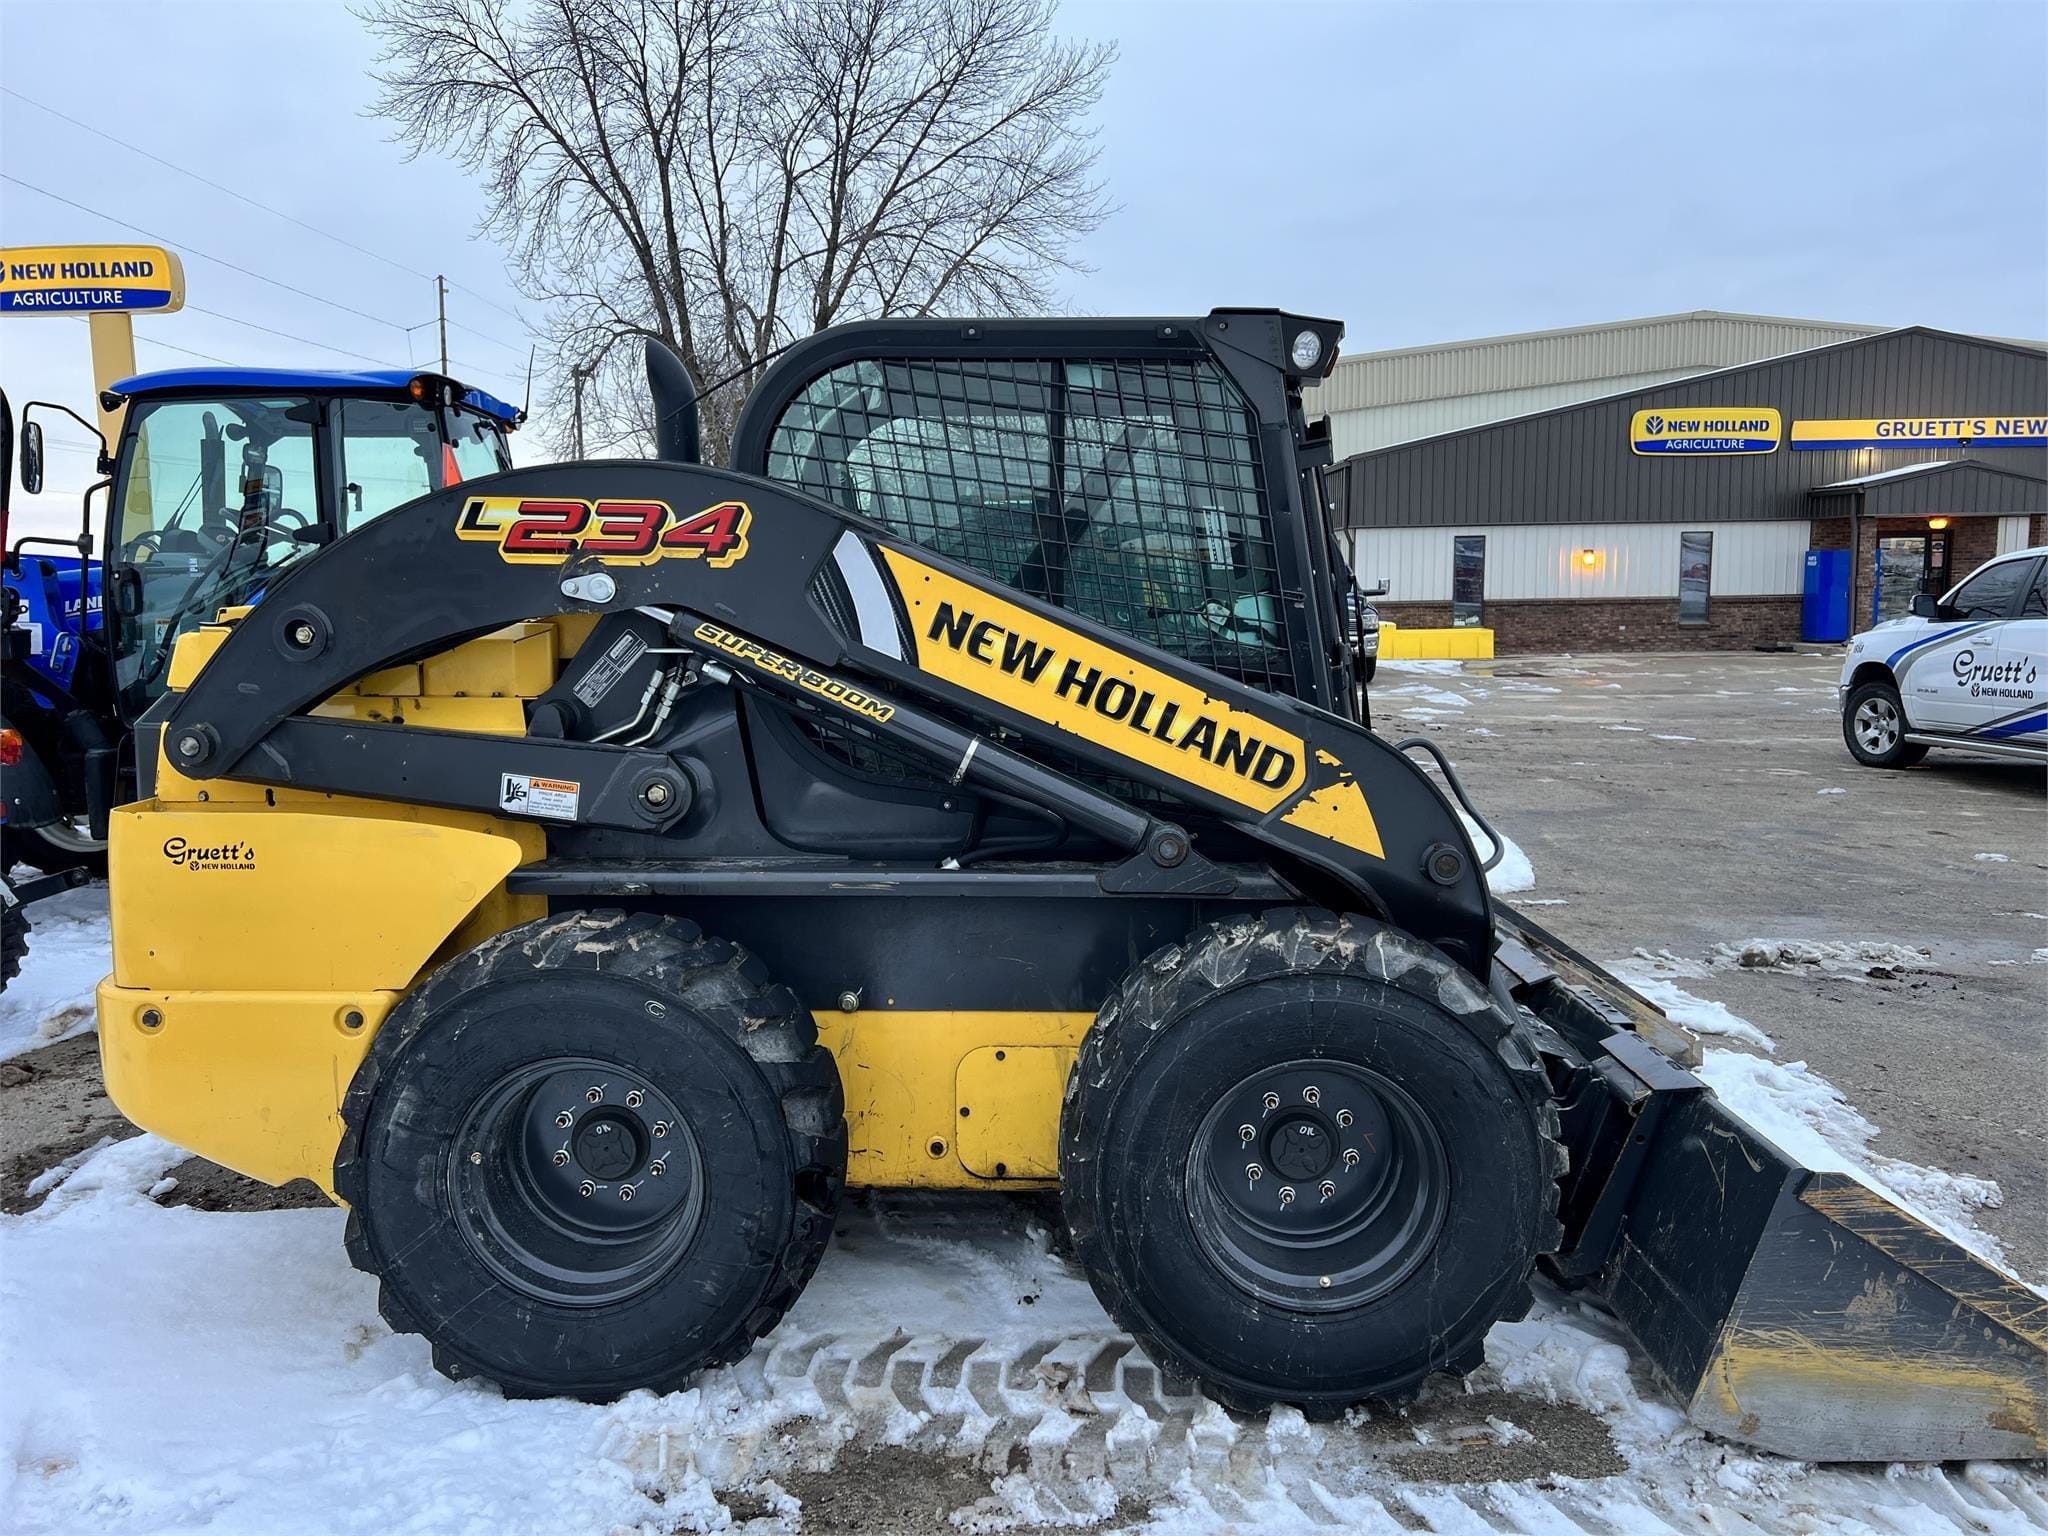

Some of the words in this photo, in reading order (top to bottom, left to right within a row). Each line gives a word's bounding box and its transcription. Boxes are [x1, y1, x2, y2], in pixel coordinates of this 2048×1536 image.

[11, 263, 55, 280] NEW
[61, 261, 153, 279] HOLLAND
[12, 291, 123, 306] AGRICULTURE
[1668, 420, 1702, 434] NEW
[1704, 420, 1770, 433] HOLLAND
[1876, 421, 1986, 437] GRUETT'S
[1996, 419, 2047, 436] NEW
[1665, 439, 1745, 450] AGRICULTURE
[1952, 649, 2037, 687] Gruett's
[926, 600, 1055, 686] NEW
[1055, 658, 1296, 791] HOLLAND
[1981, 687, 1998, 697] NEW
[1999, 688, 2034, 699] HOLLAND
[541, 782, 574, 791] WARNING
[163, 837, 255, 865] Gruett's
